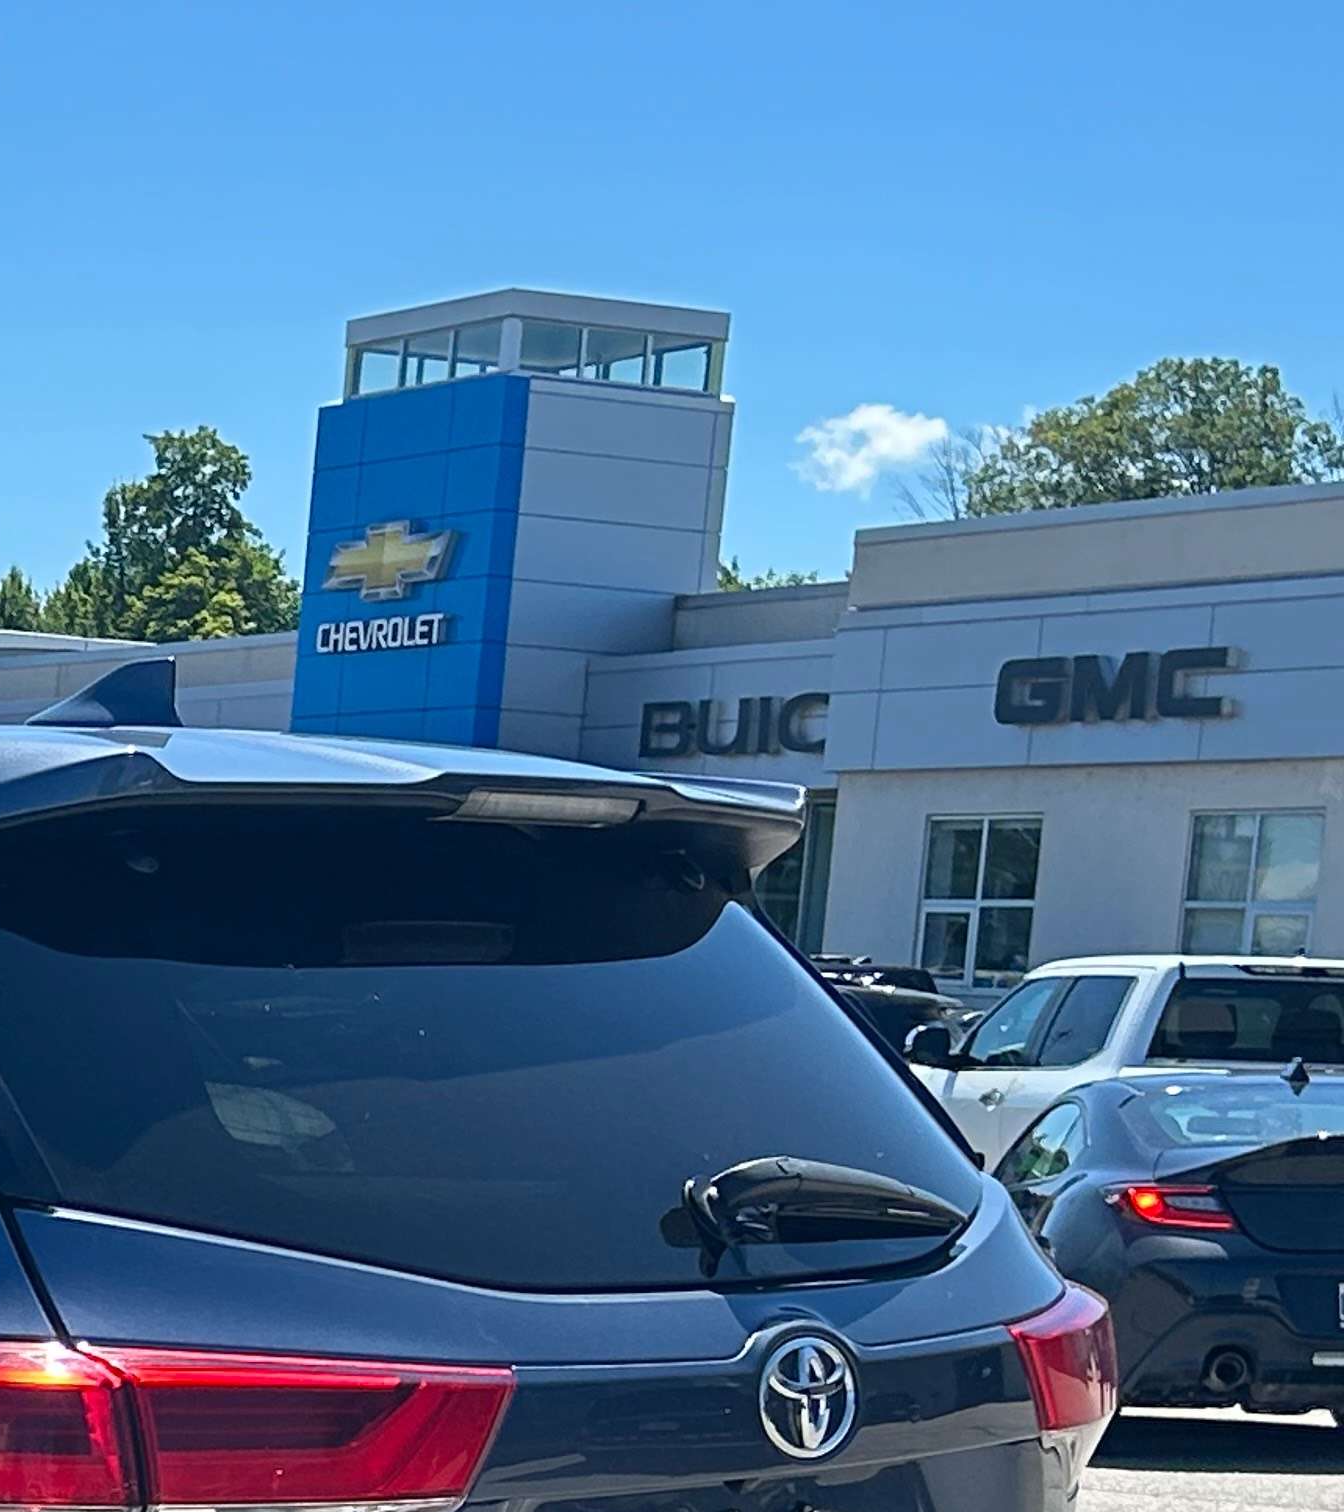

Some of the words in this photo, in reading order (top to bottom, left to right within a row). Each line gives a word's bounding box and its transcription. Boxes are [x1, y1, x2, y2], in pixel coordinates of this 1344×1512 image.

[315, 612, 445, 653] CHEVROLET
[993, 646, 1236, 725] GMC
[638, 692, 830, 758] BUIC
